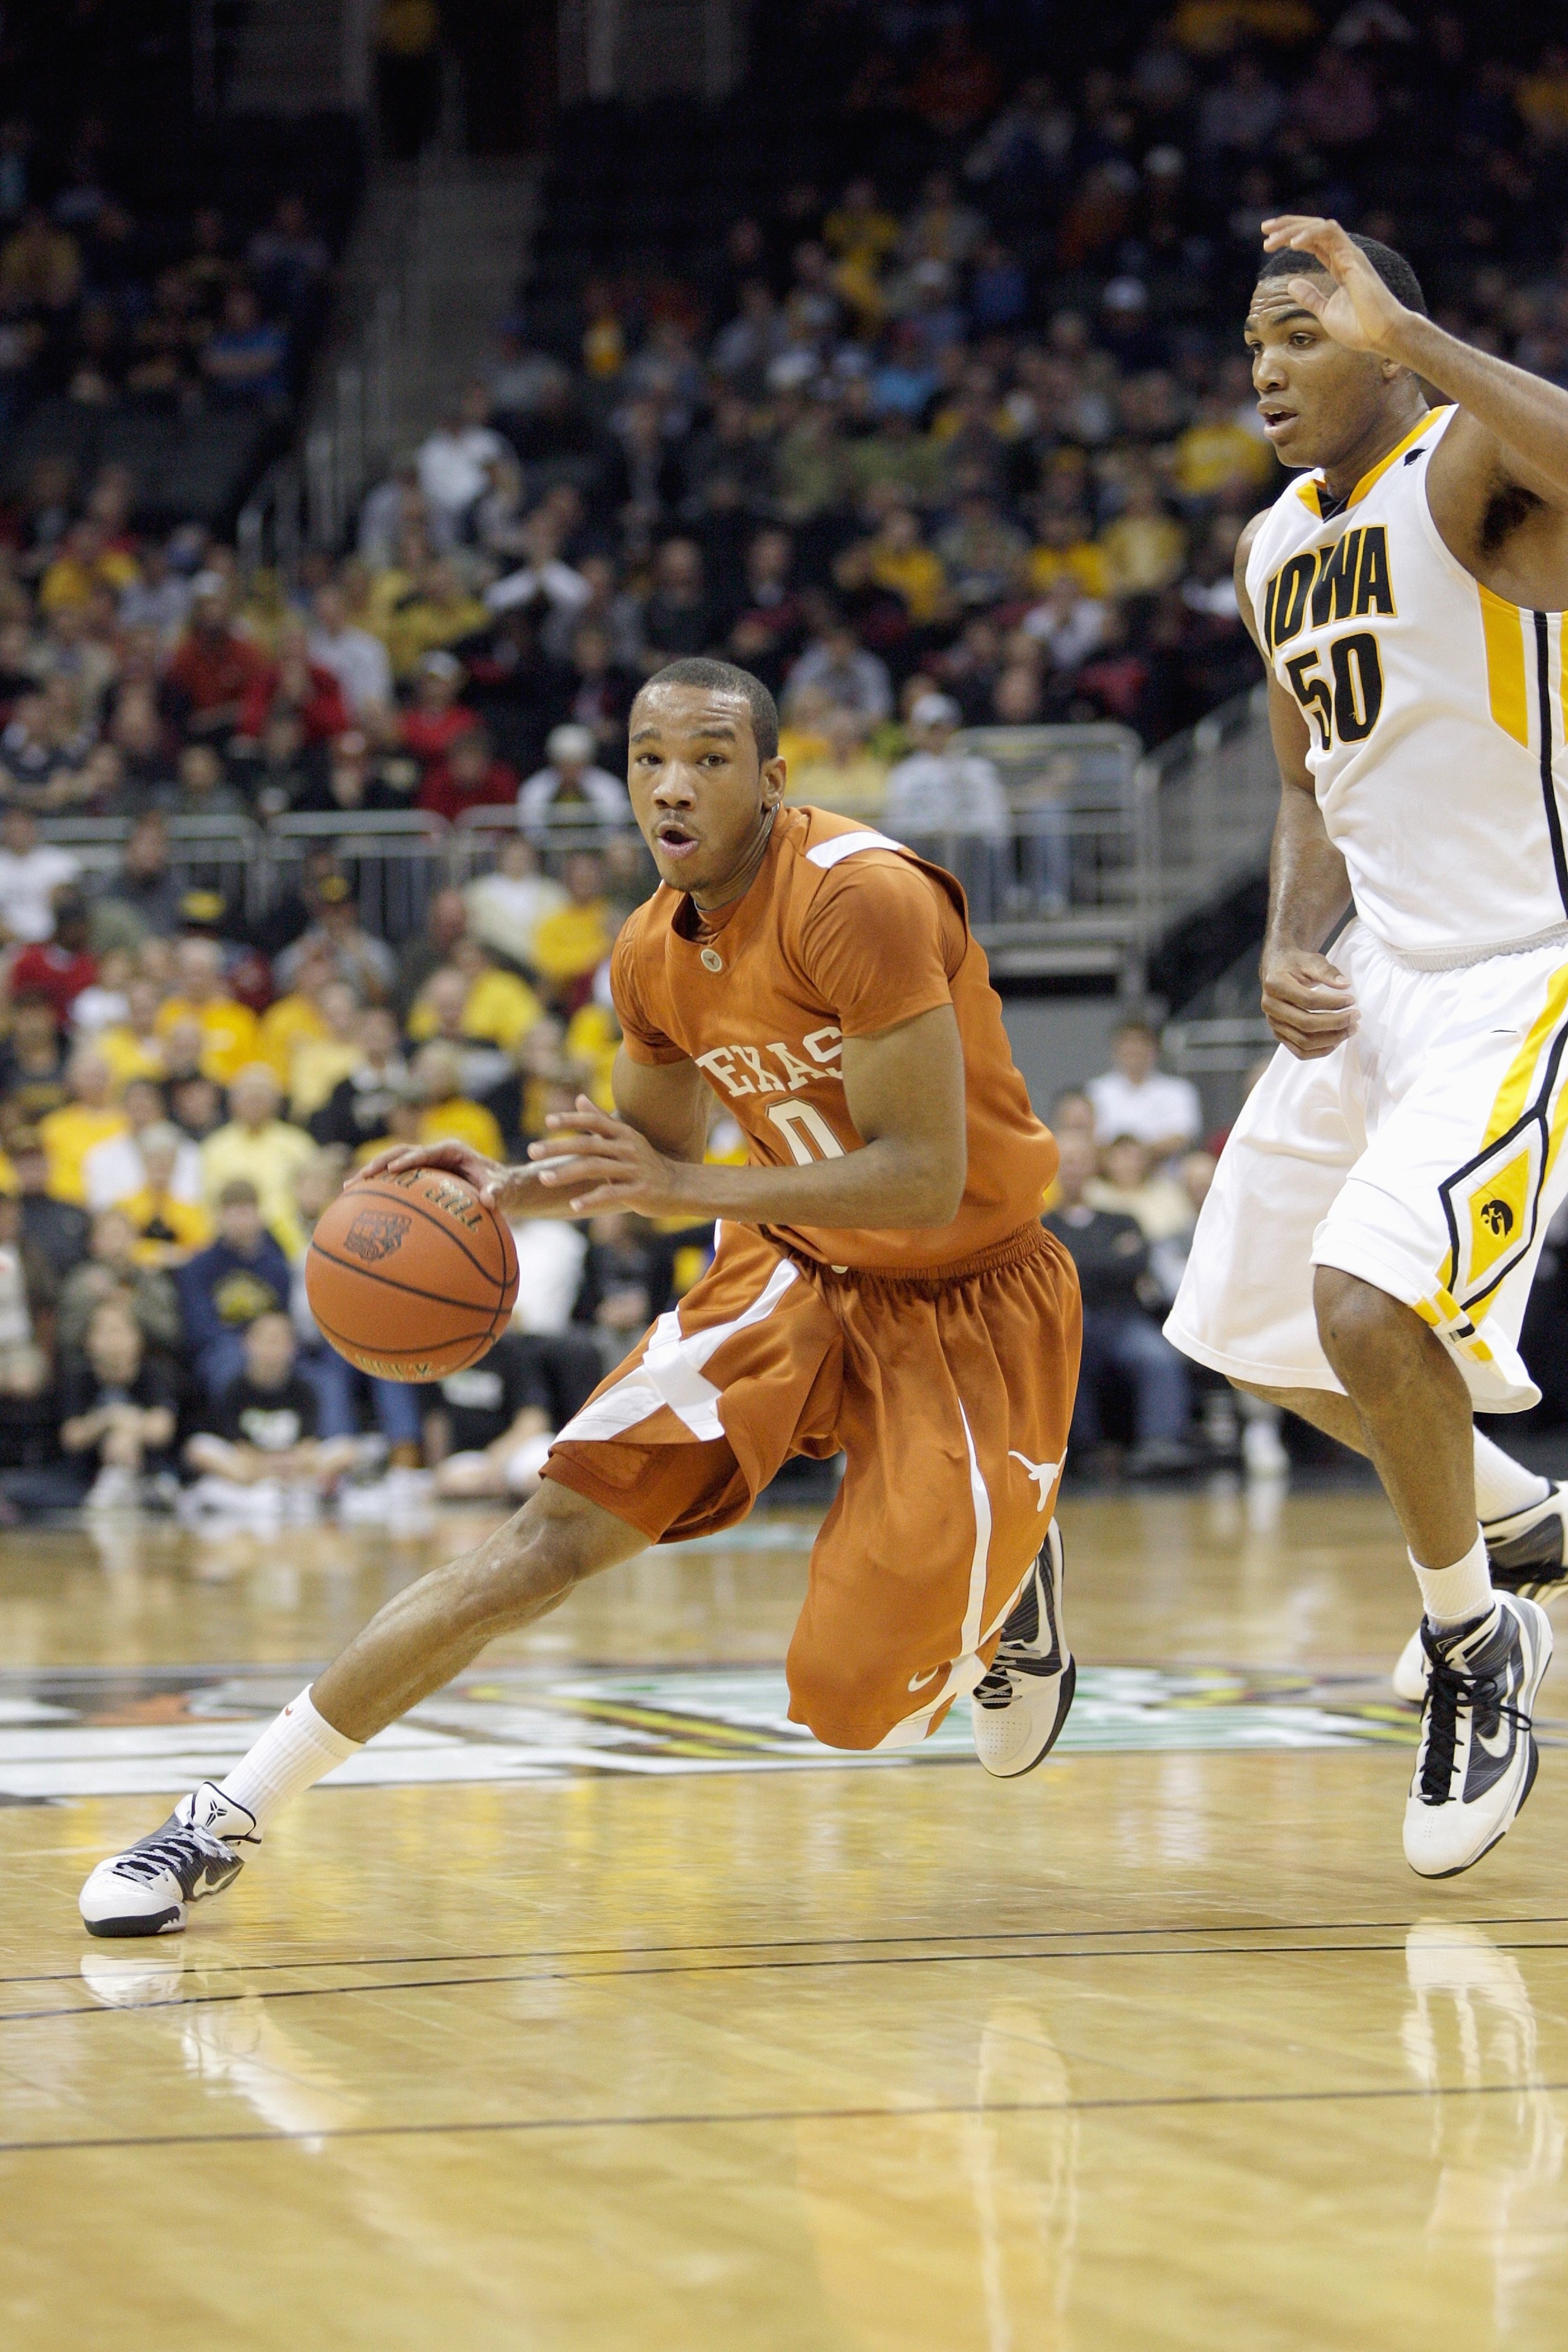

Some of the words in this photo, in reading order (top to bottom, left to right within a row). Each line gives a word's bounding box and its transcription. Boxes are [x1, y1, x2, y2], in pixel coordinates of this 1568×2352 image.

[1264, 524, 1398, 666] IOWA
[1285, 630, 1385, 753] 50
[690, 1026, 843, 1097] EXAS
[765, 1096, 846, 1166] 0
